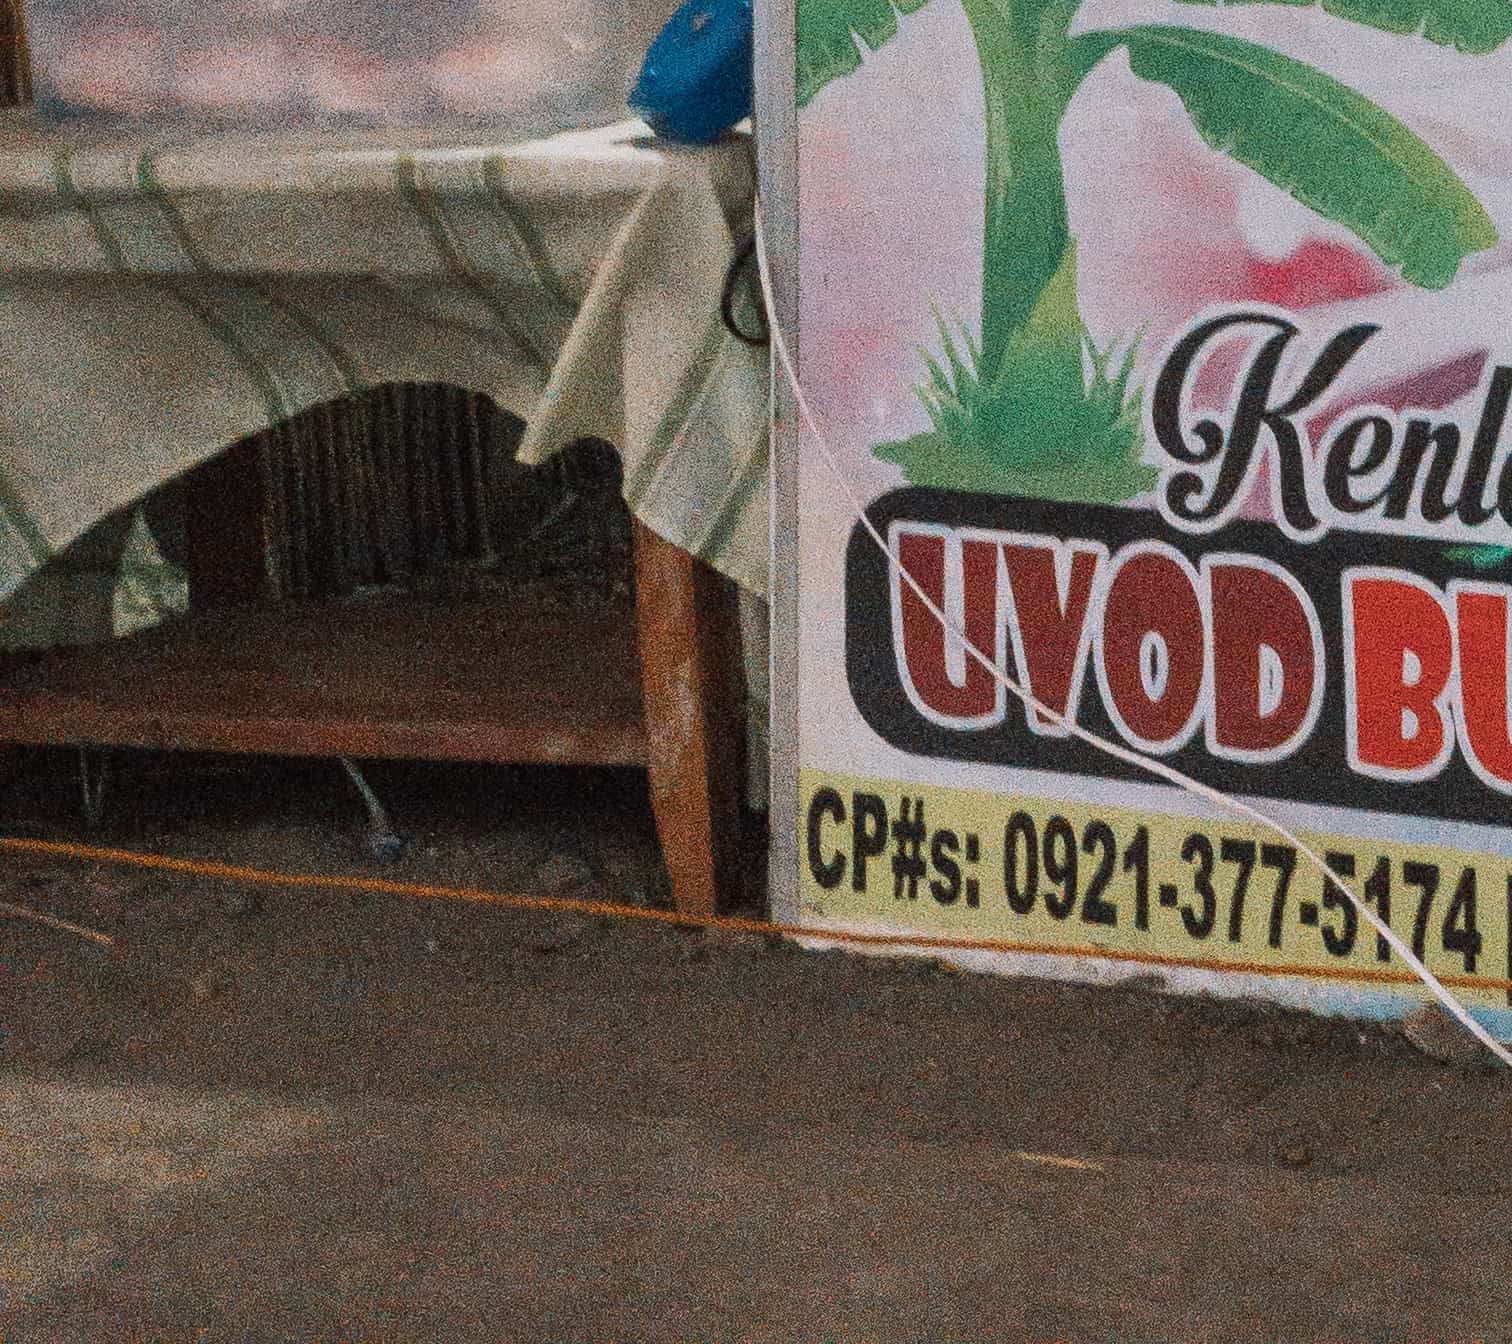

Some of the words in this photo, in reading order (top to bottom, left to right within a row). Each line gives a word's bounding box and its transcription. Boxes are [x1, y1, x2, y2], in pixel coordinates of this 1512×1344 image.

[888, 522, 1325, 765] UVOD
[806, 786, 981, 909] CP#s:
[1003, 811, 1483, 973] 0921-377-5174
